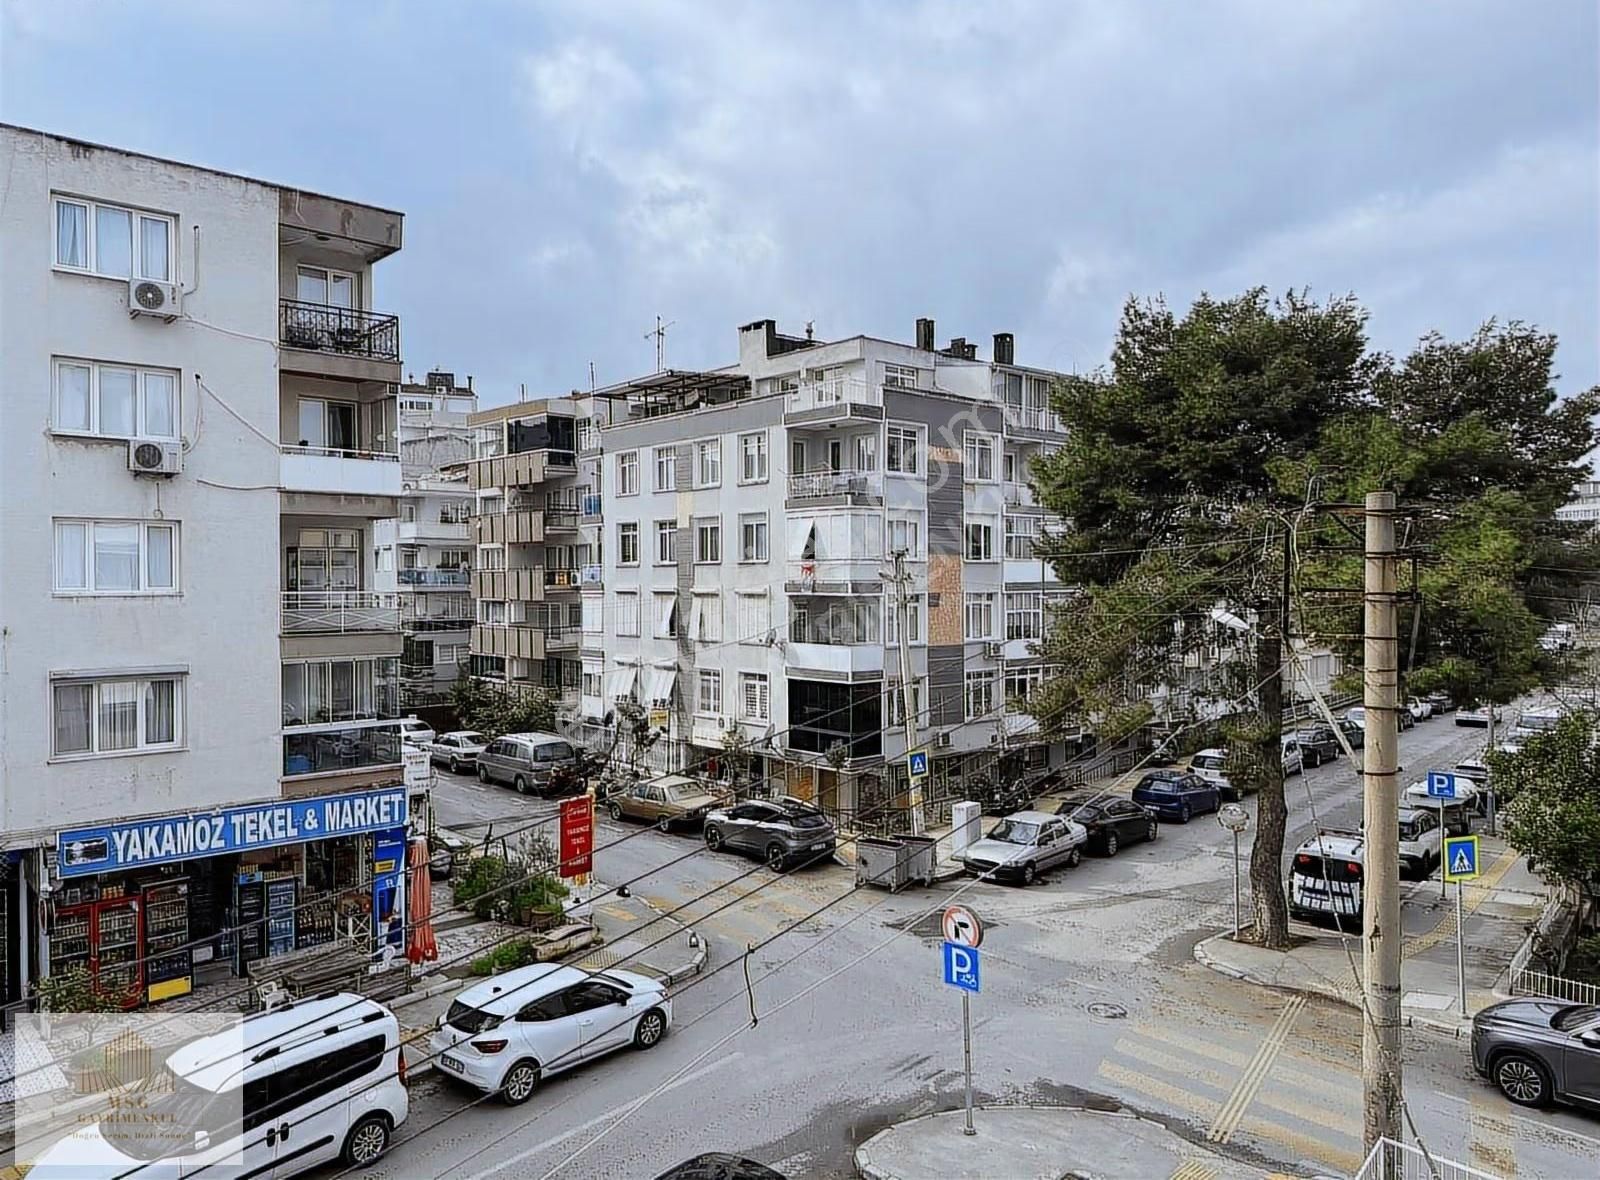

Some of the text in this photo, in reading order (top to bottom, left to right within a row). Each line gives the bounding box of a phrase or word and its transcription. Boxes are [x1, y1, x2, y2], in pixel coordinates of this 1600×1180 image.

[1433, 775, 1448, 794] P
[112, 793, 404, 863] YAKAMOZ TEKEL & MARKET
[951, 946, 971, 983] P
